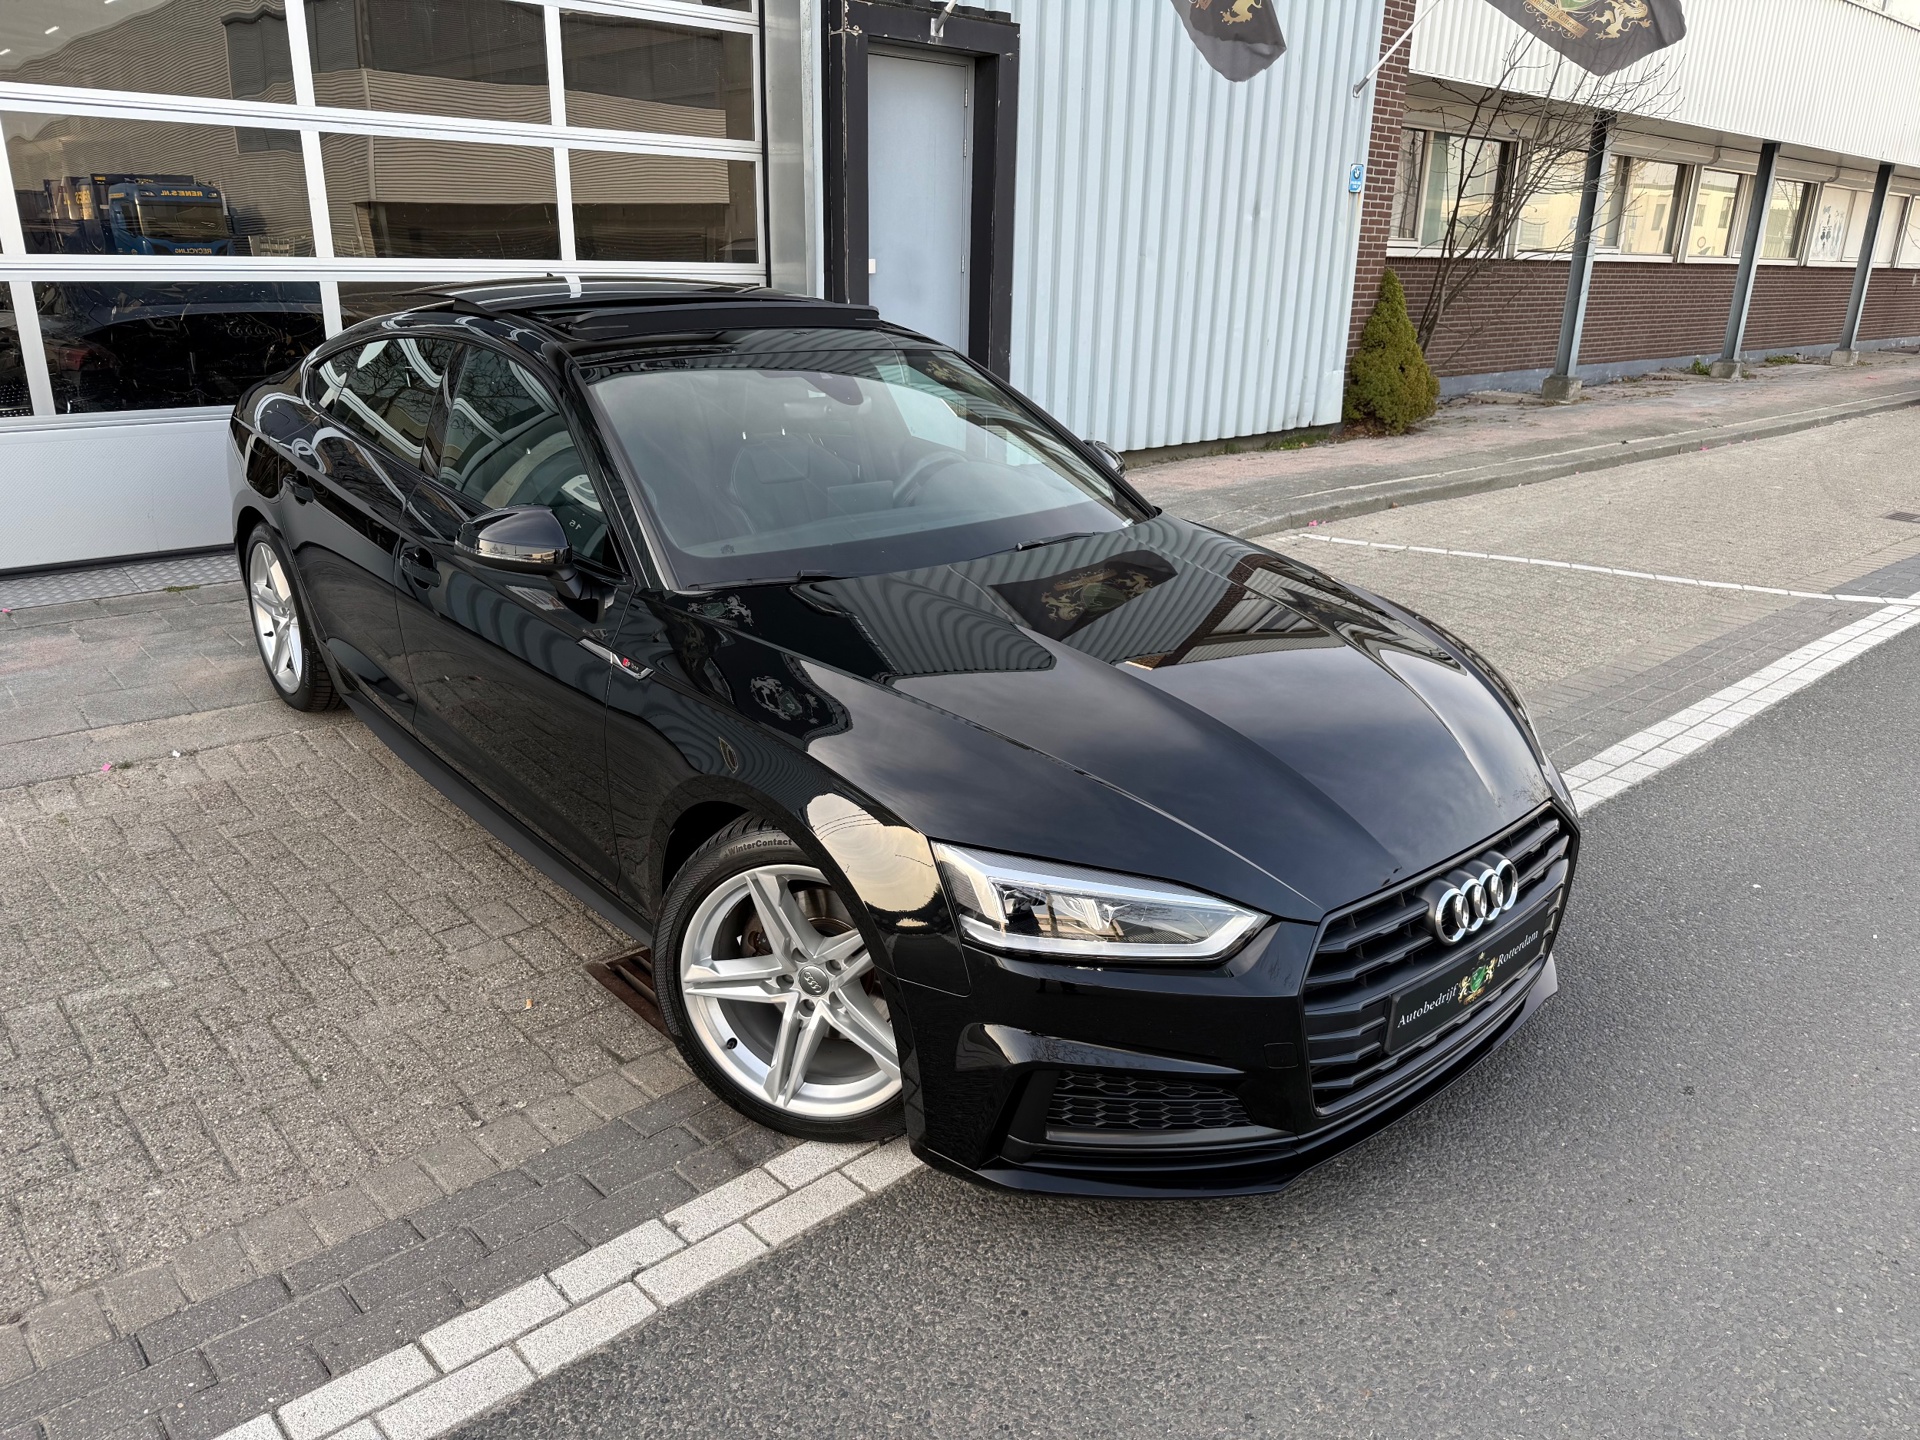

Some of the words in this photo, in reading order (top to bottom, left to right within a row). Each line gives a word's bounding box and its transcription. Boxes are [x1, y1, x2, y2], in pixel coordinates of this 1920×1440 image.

[727, 838, 793, 856] WinterContact
[1397, 982, 1459, 1029] Autobedrijf
[1497, 930, 1540, 968] Rotterdam
